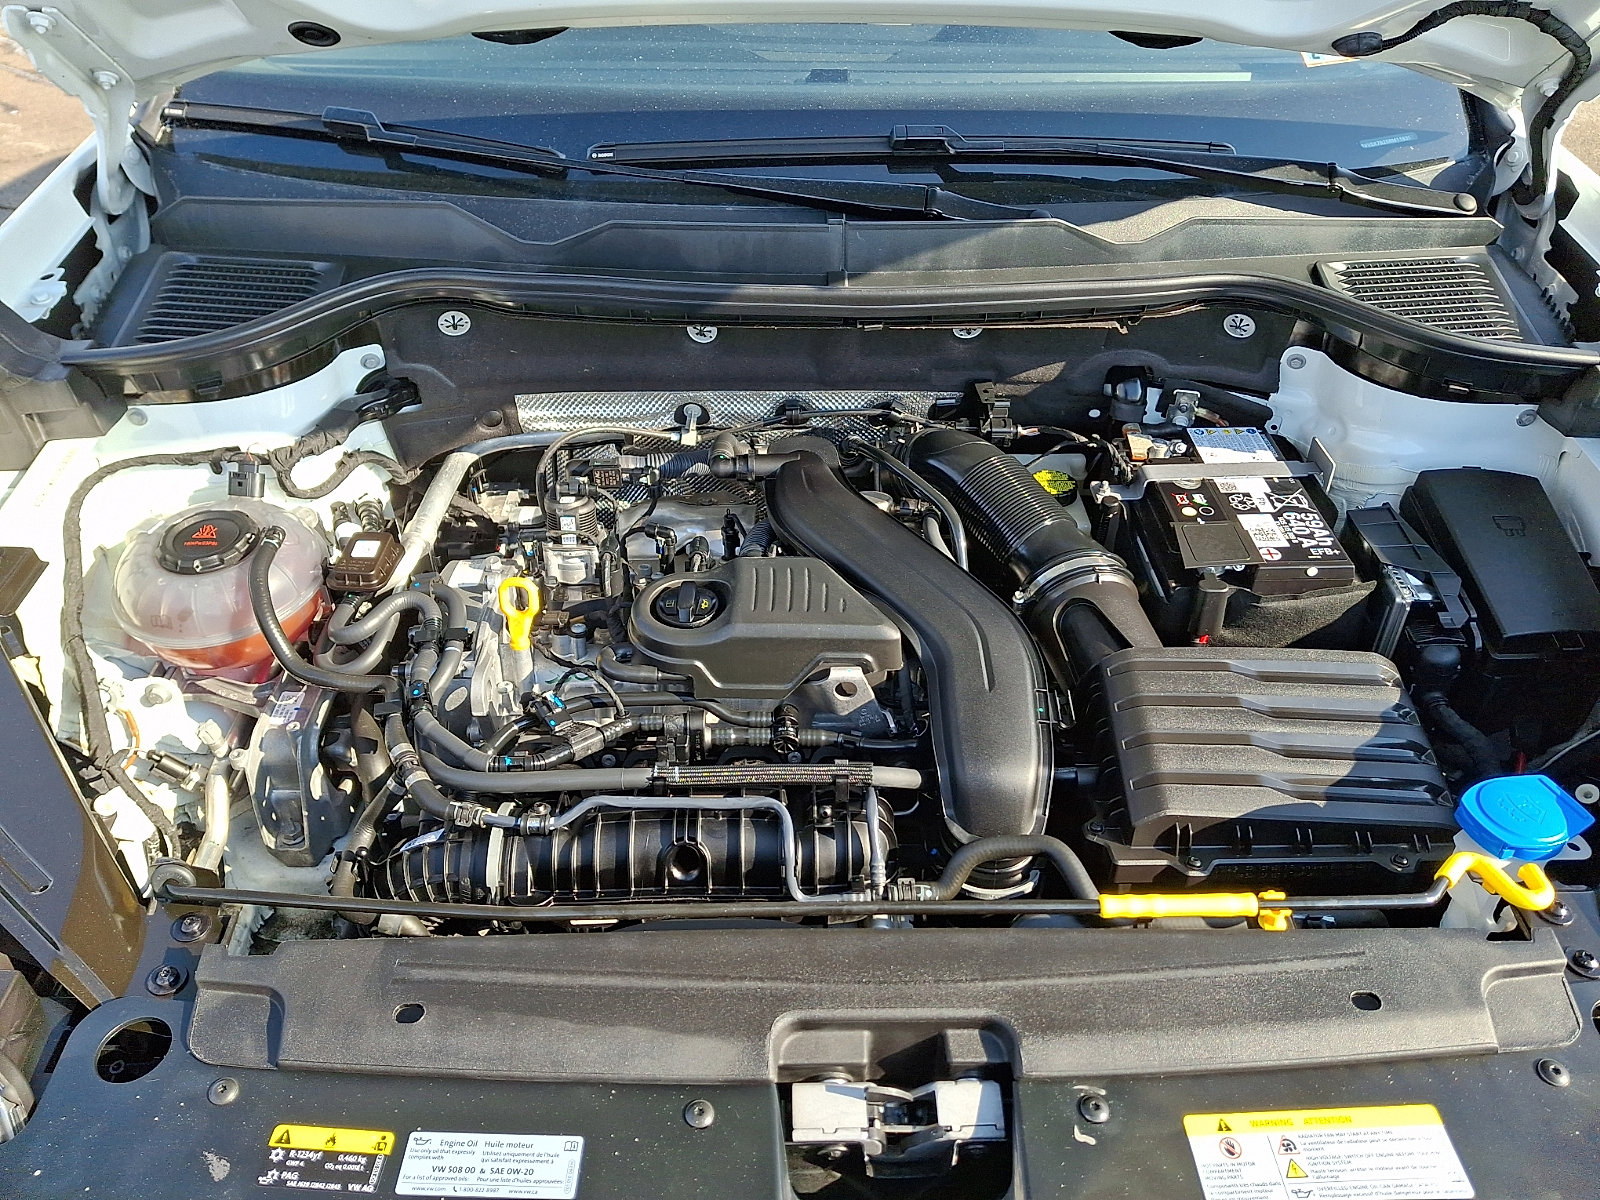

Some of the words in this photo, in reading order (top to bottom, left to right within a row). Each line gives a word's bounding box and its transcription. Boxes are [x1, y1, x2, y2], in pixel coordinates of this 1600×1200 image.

[1282, 512, 1311, 535] 640
[1297, 536, 1318, 548] A
[1300, 512, 1334, 546] 59Ah
[1309, 548, 1341, 556] EFB+
[1250, 1118, 1294, 1127] WARNING
[1304, 1116, 1352, 1125] ATTENTION
[440, 1139, 466, 1148] Engine
[289, 1150, 324, 1161] R-1234yf
[281, 1171, 299, 1180] PAG
[362, 1184, 375, 1193] AG
